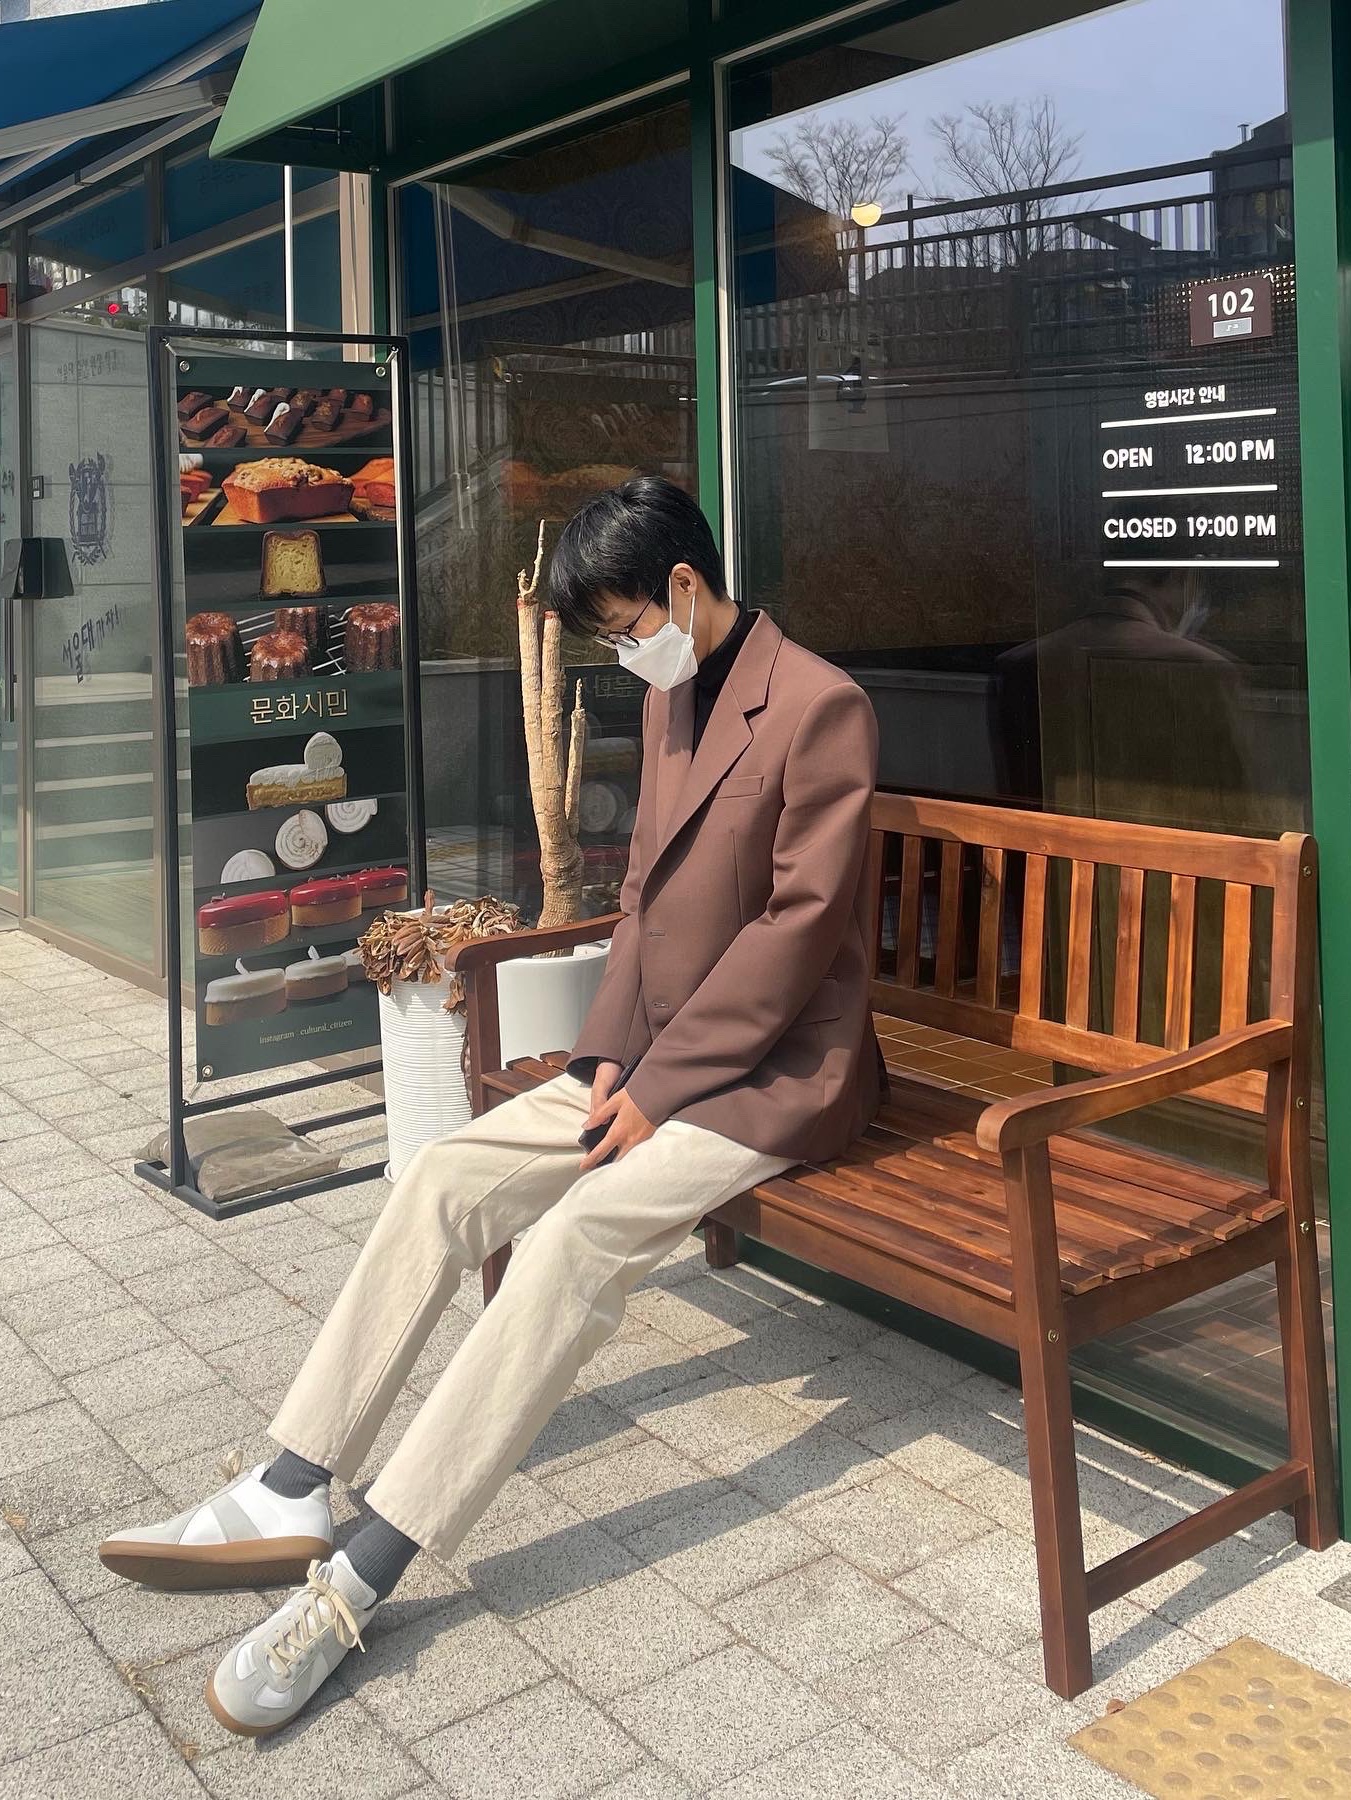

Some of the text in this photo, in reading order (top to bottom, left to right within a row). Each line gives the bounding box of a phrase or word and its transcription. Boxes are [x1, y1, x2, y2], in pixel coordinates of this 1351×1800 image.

[1207, 287, 1255, 317] 102
[1144, 384, 1225, 409] 영업시간 안내
[1102, 439, 1275, 470] OPEN 12:00 PM
[1104, 514, 1276, 539] CLOSED 19:00 PM
[249, 688, 349, 725] 문화시민
